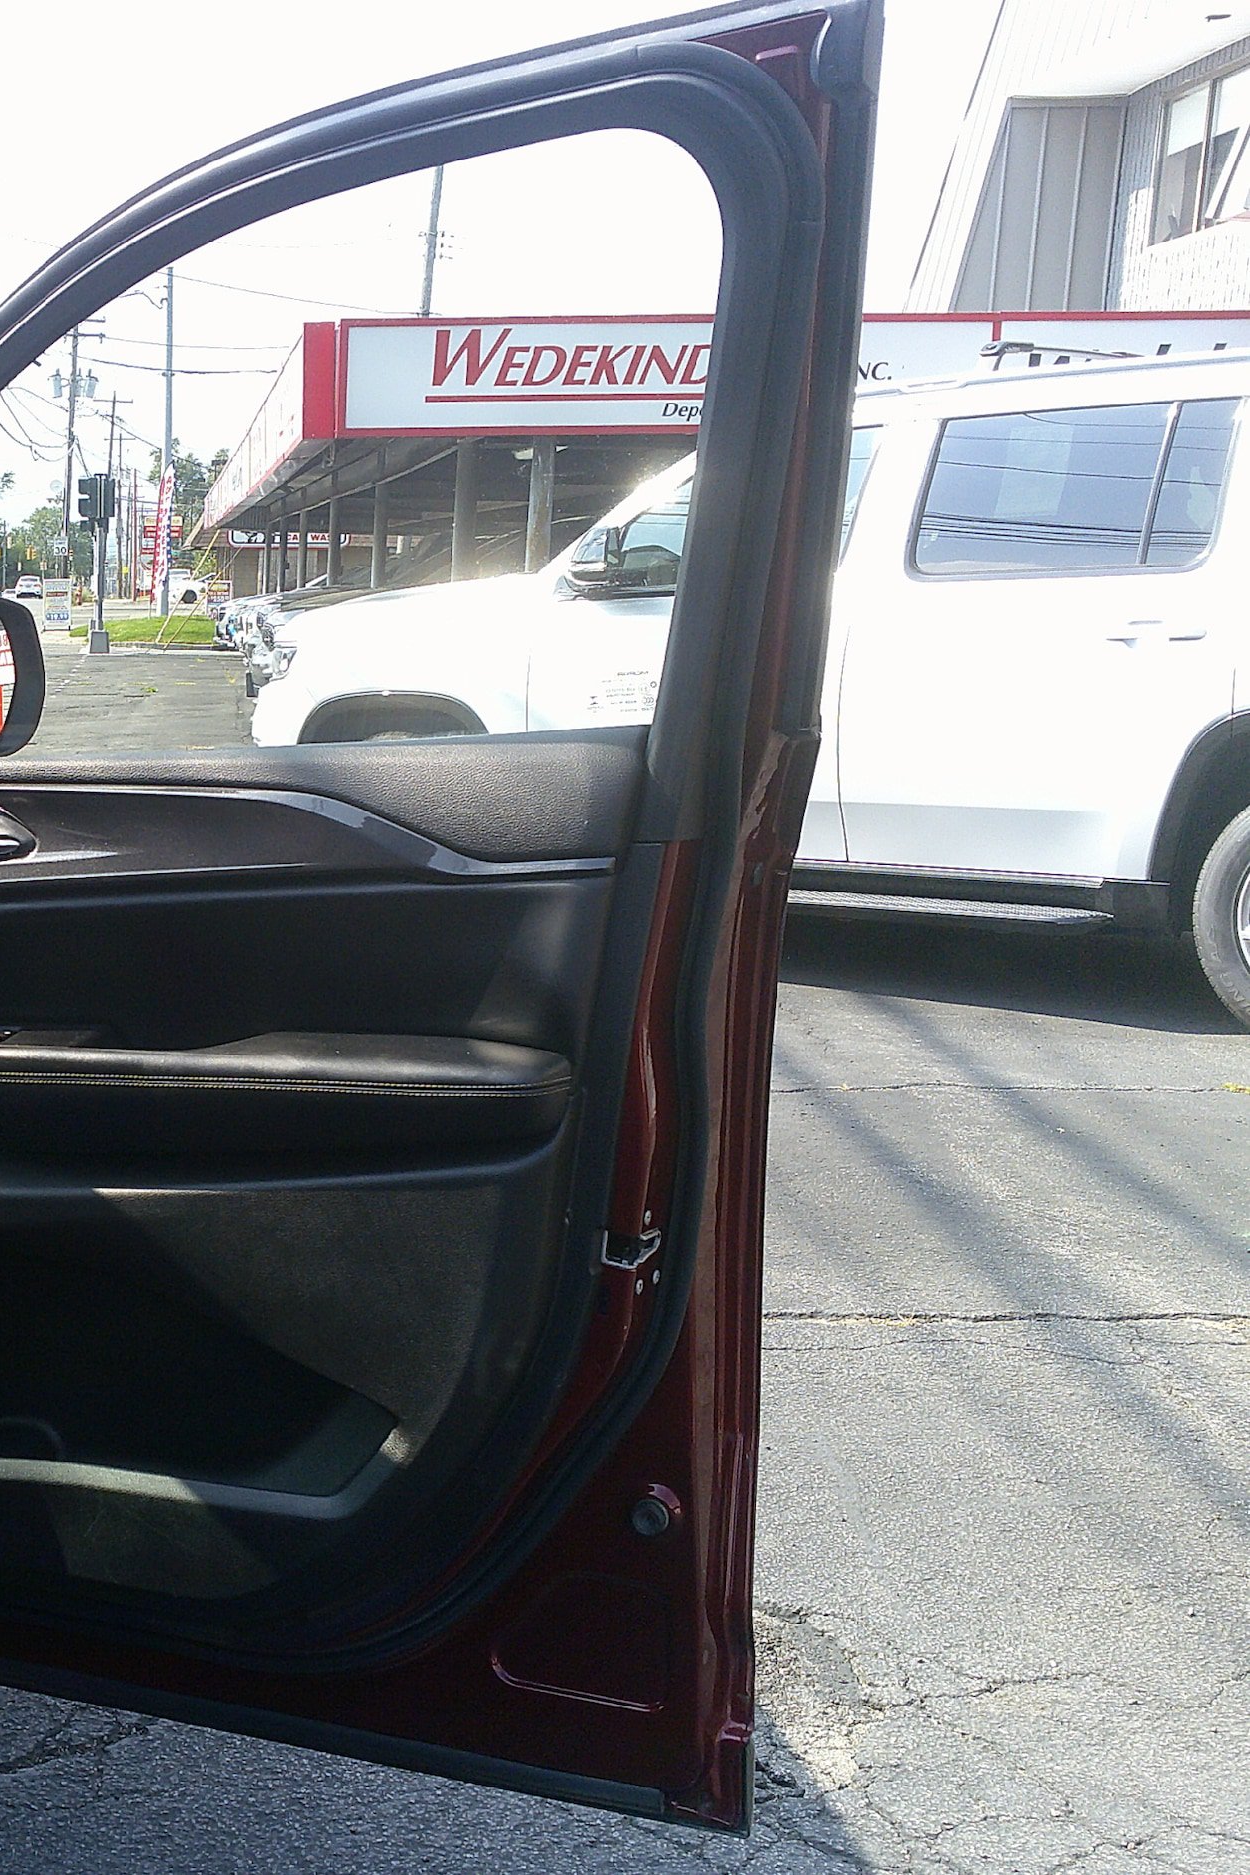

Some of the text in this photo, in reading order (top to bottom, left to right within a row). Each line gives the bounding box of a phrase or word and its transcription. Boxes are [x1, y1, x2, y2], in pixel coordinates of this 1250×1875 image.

[432, 328, 711, 386] WEDEKIND
[858, 361, 892, 381] NC.
[662, 402, 702, 422] Dep
[55, 546, 67, 555] 30
